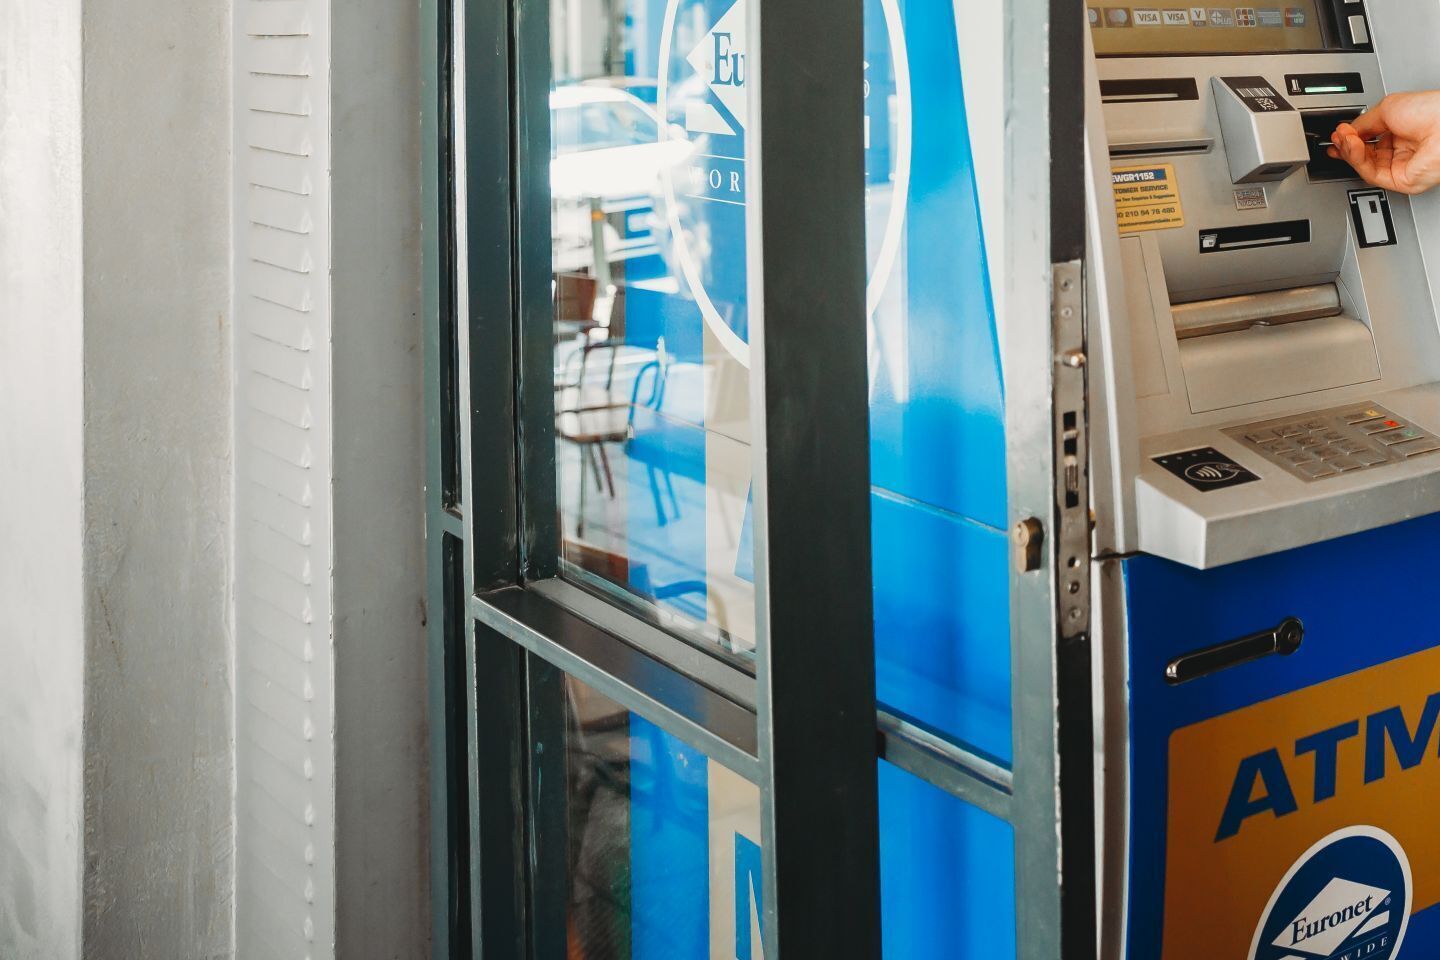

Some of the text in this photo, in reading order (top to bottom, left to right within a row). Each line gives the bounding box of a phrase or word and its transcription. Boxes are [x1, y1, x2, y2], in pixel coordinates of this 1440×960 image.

[1137, 13, 1158, 22] VISA
[1167, 12, 1186, 21] VISA
[711, 31, 745, 88] Eu
[1289, 894, 1374, 946] Euronet
[1340, 936, 1388, 960] WIDE
